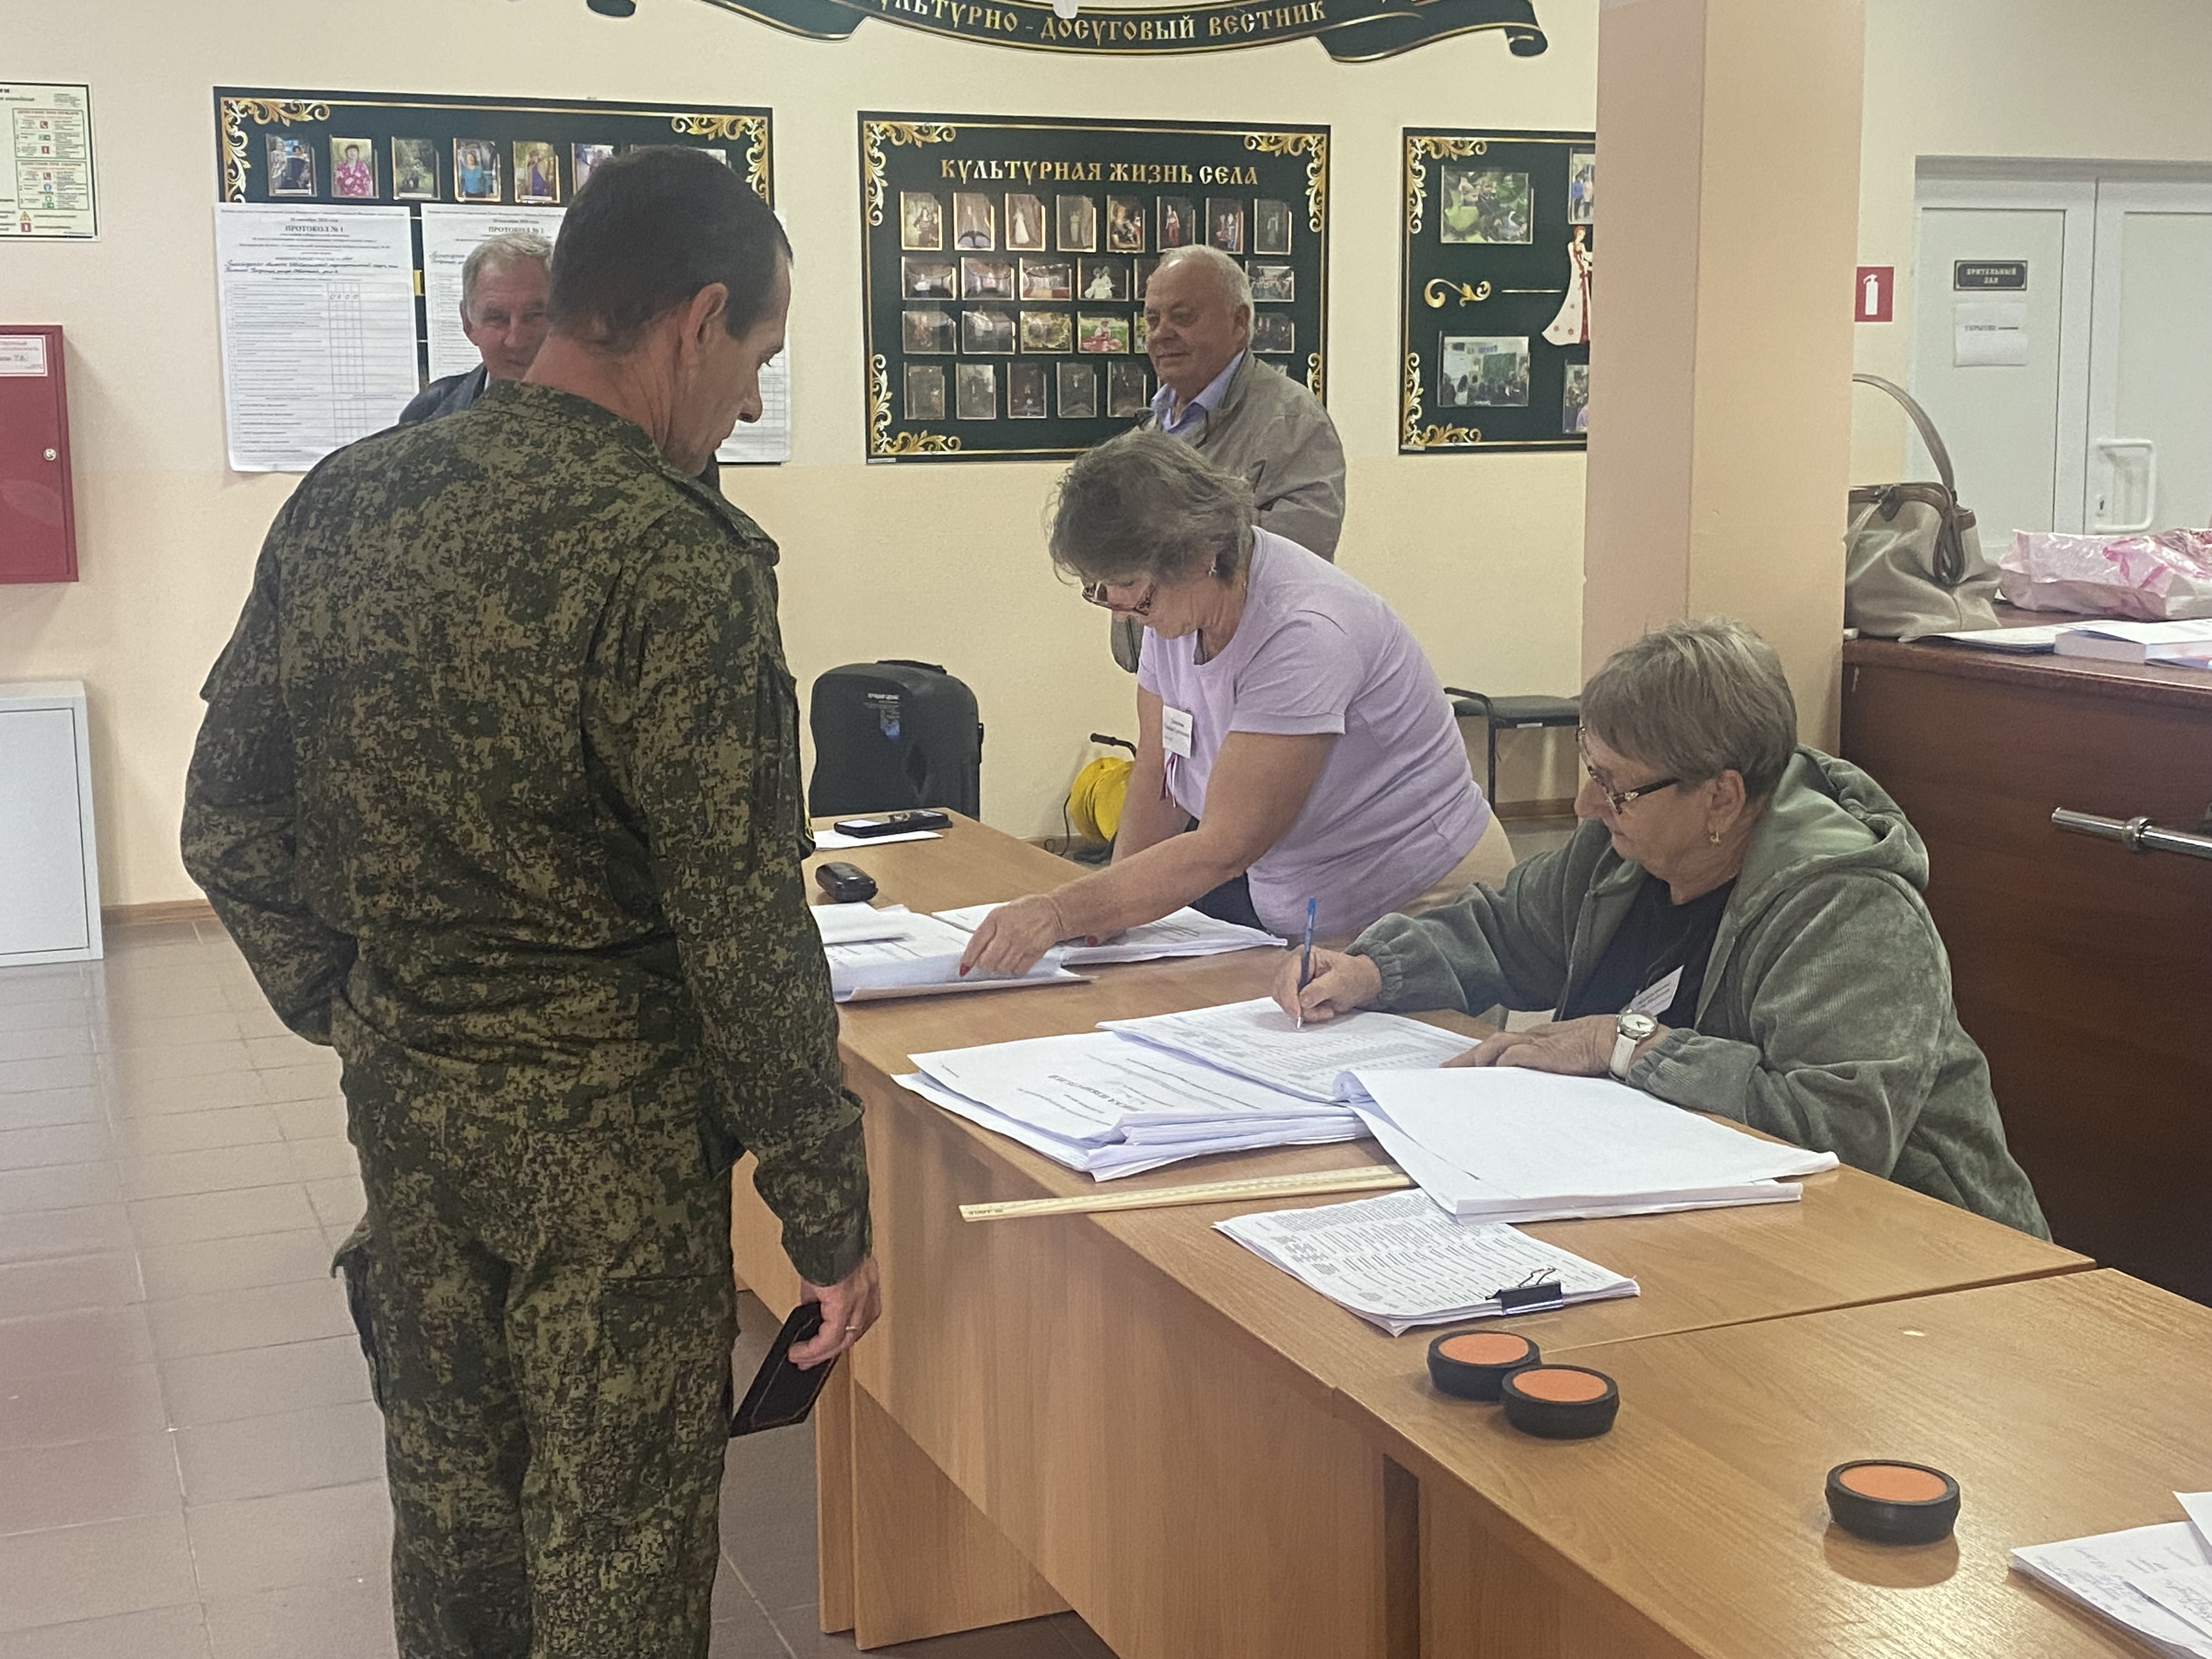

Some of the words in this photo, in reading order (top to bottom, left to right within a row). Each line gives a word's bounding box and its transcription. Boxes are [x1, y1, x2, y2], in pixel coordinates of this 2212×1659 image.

[1040, 15, 1195, 46] ДОСУГОВЫЙ
[1209, 2, 1327, 36] ВЕСТНИК
[940, 160, 1102, 185] КУЛЬТУРНАЯ
[1109, 163, 1193, 185] ЖИЗНЬ
[1199, 166, 1259, 185] СЕЛА
